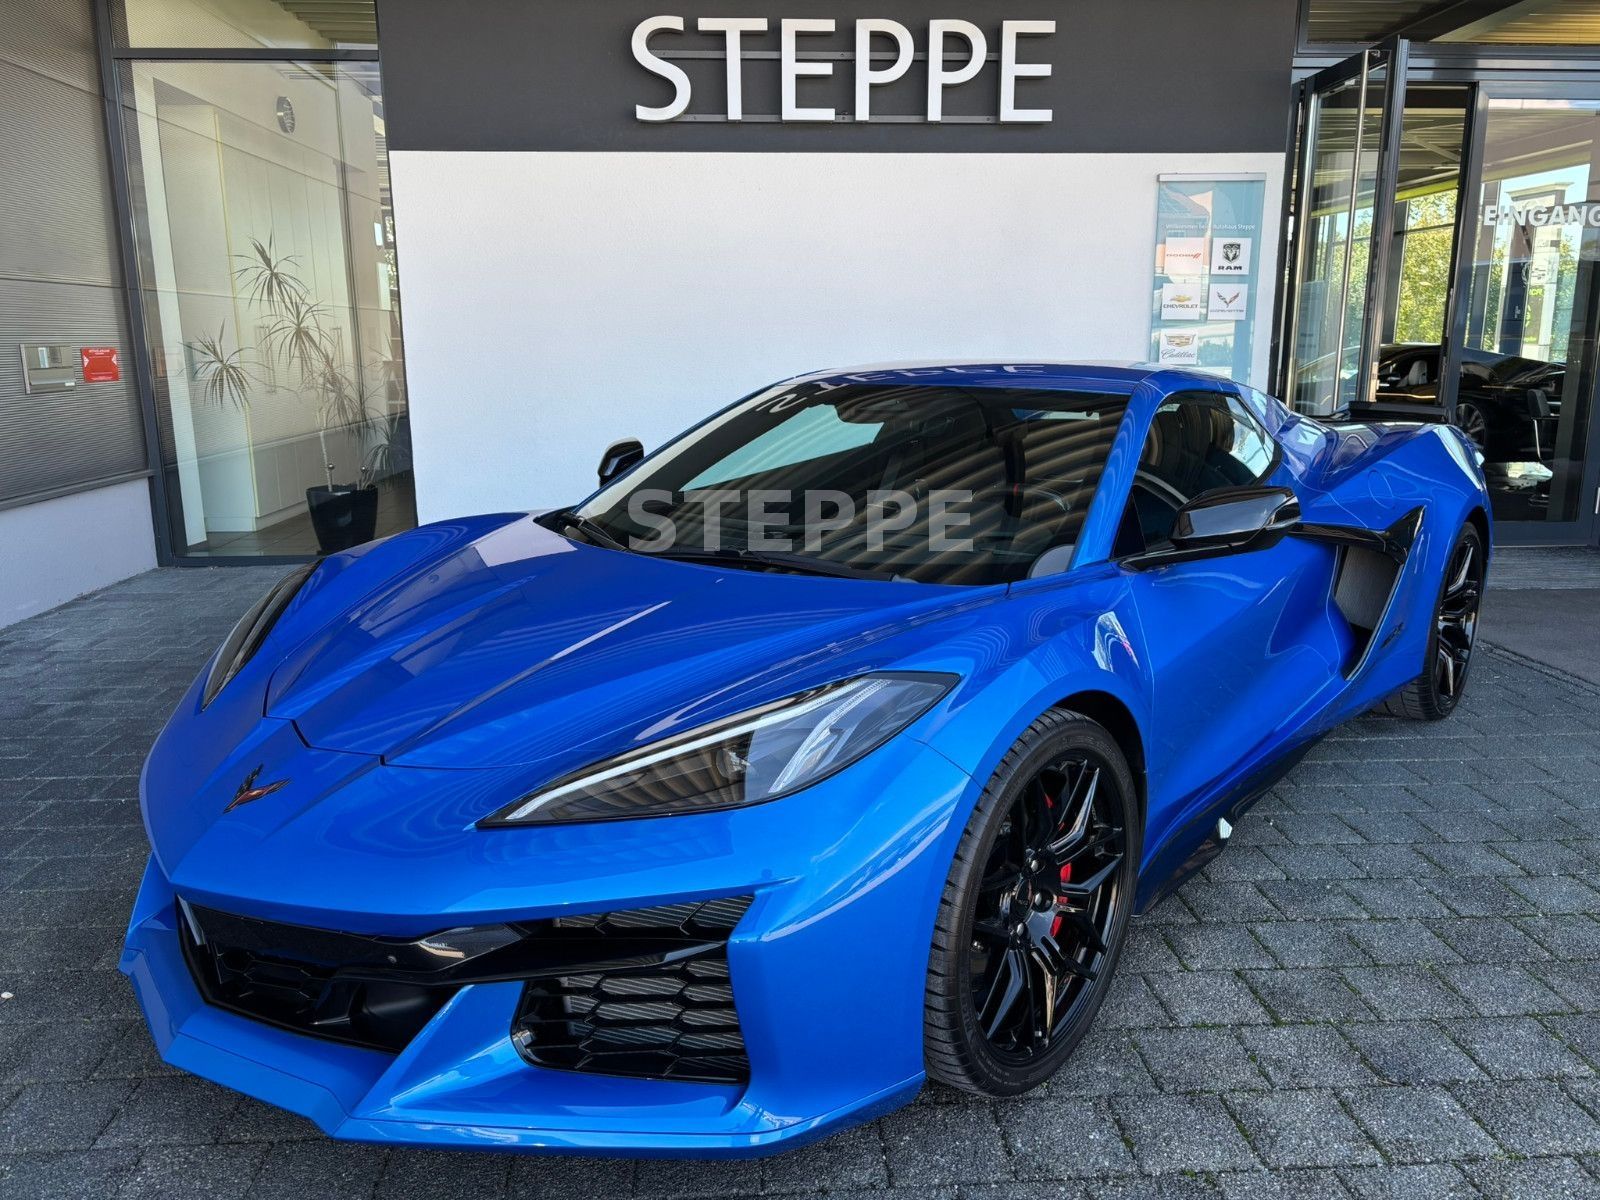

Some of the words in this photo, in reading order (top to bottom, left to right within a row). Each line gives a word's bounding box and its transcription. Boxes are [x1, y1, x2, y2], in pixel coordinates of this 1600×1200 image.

[631, 15, 1056, 122] STEPPE
[1483, 204, 1600, 227] EINGANG
[1161, 348, 1195, 360] Cadillac
